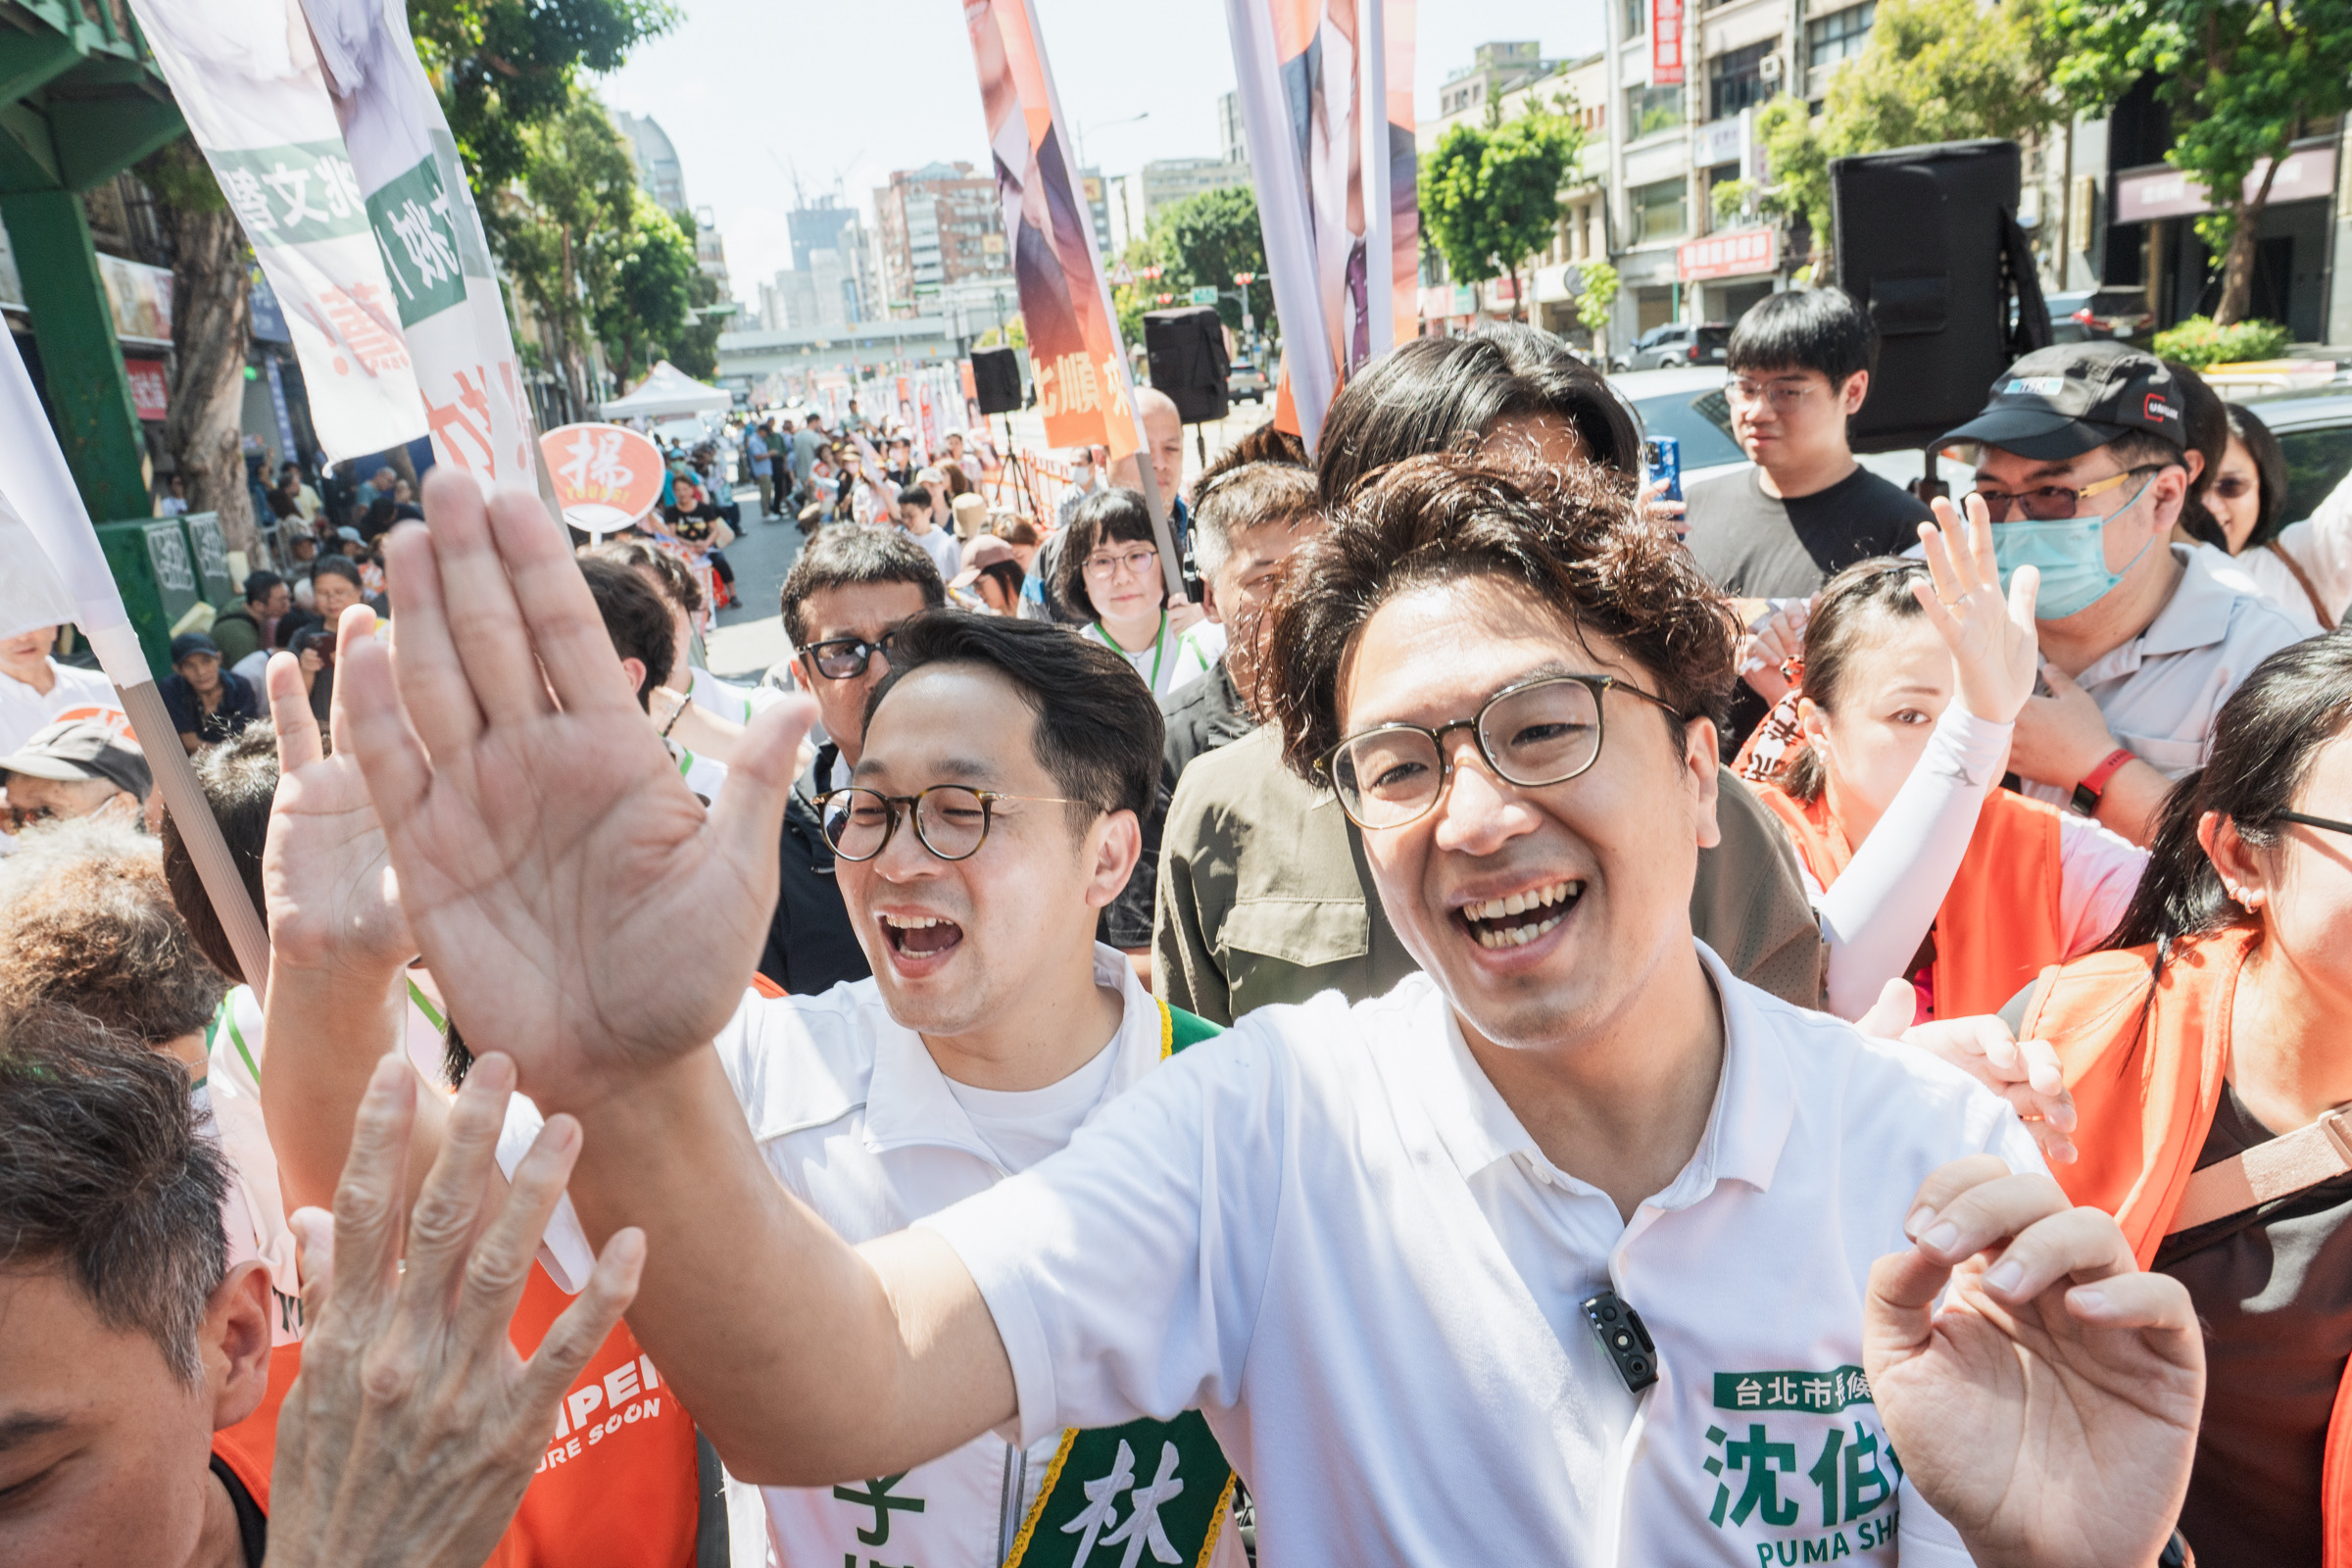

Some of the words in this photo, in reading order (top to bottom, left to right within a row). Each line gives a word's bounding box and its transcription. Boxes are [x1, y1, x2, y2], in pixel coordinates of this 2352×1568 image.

[588, 1396, 662, 1446] SOON
[1059, 1438, 1184, 1568] 林
[1702, 1420, 1904, 1529] 沈伯
[1756, 1531, 1850, 1568] PUMA
